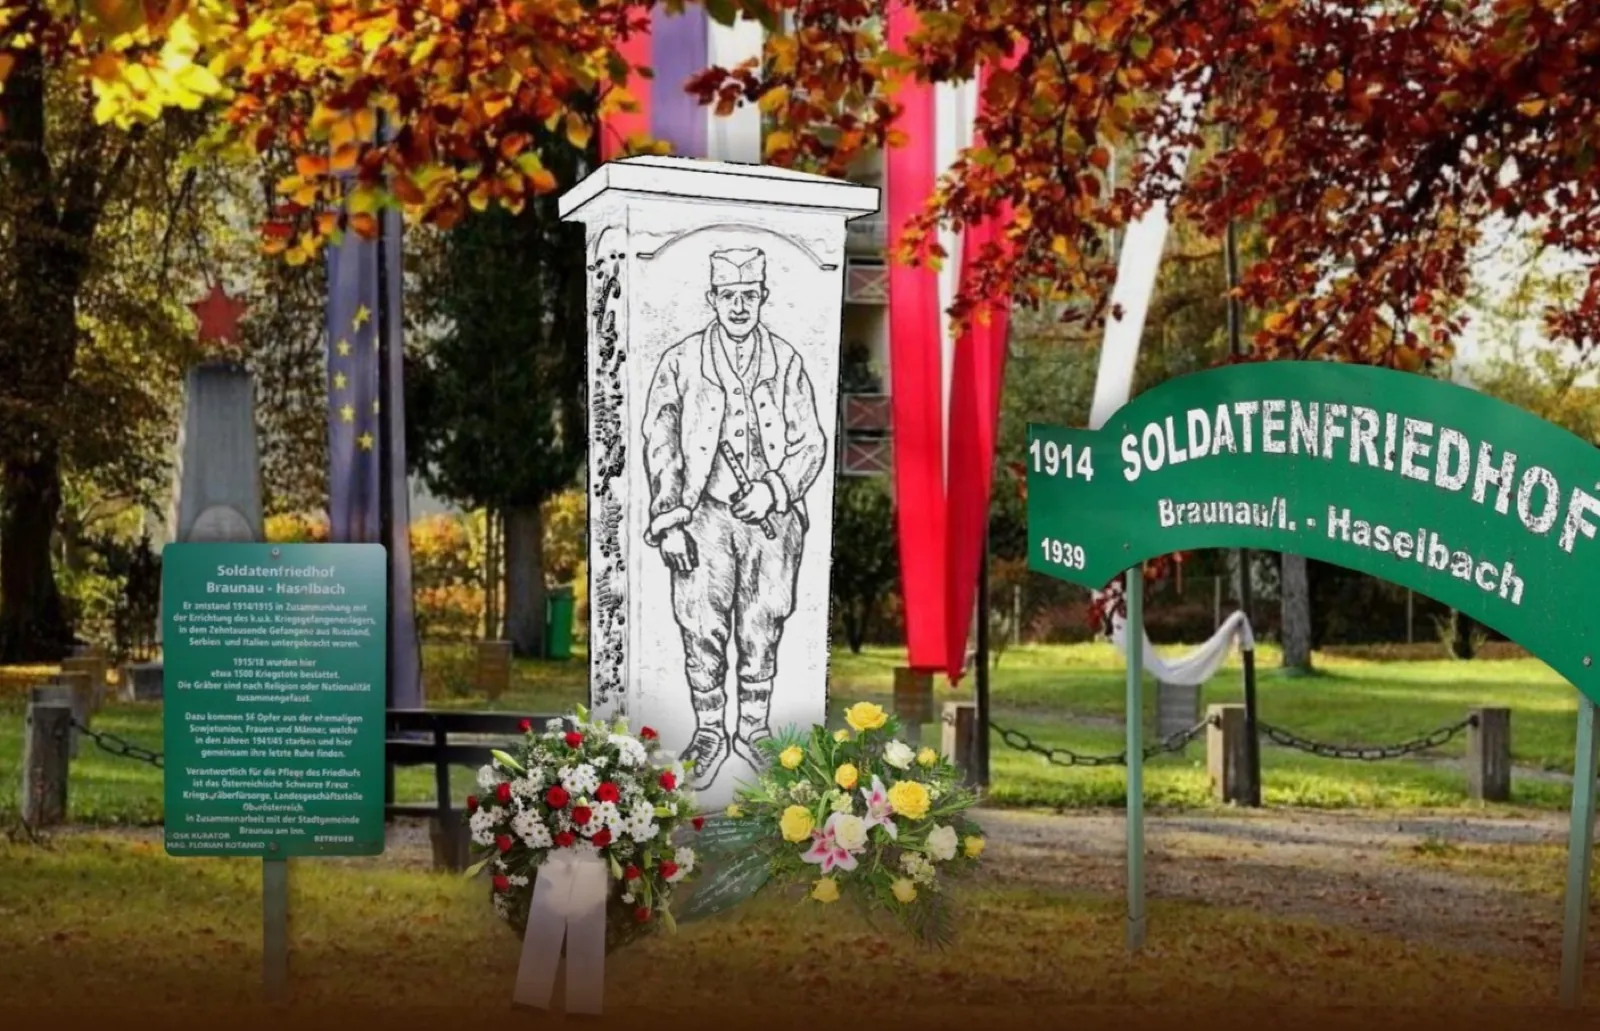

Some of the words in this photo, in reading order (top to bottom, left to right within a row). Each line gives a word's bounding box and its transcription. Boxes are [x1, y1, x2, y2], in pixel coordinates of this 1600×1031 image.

[1030, 439, 1094, 482] 1914
[1121, 399, 1600, 553] SOLDATENFRIEDHOF
[1041, 537, 1086, 570] 1939
[1327, 505, 1525, 605] Haselbach
[217, 565, 335, 577] Soldatenfriedhof
[206, 582, 264, 593] Braunau
[276, 583, 345, 594] Haselbach
[183, 602, 191, 610] Er
[275, 602, 283, 611] in
[286, 603, 351, 613] Zusammenhang
[173, 613, 187, 622] der
[189, 614, 232, 624] Errichtung
[179, 626, 187, 634] in
[189, 626, 207, 634] dem
[209, 626, 267, 635] Zehntausende
[269, 627, 314, 636] Gefangene
[189, 637, 221, 646] Serbien
[225, 638, 241, 646] und
[243, 638, 269, 646] Italien
[272, 638, 330, 649] untergebracht
[266, 658, 297, 667] wurden
[299, 658, 316, 667] hier
[211, 669, 232, 677] etwa
[255, 670, 298, 680] Kriegstote
[178, 681, 191, 690] Die
[193, 681, 221, 690] Gräber
[223, 681, 241, 690] sind
[243, 681, 262, 690] nach
[264, 682, 298, 692] Religion
[300, 682, 320, 690] oder
[321, 682, 371, 691] Nationalität
[185, 712, 206, 720] Dazu
[207, 712, 243, 720] kommen
[257, 712, 280, 723] Opfer
[282, 714, 297, 722] aus
[299, 713, 313, 722] der
[314, 714, 363, 724] ehemaligen
[246, 725, 274, 733] Frauen
[276, 725, 292, 733] und
[329, 726, 358, 734] welche
[195, 736, 203, 744] in
[205, 736, 221, 744] den
[222, 736, 249, 744] Jahren
[285, 736, 316, 745] starben
[318, 737, 334, 745] und
[336, 737, 353, 746] hier
[201, 748, 248, 758] gemeinsam
[250, 748, 266, 757] ihre
[269, 749, 292, 757] letzte
[294, 749, 315, 757] Ruhe
[186, 766, 247, 776] Verantwortlich
[248, 766, 261, 776] für
[263, 767, 276, 776] die
[278, 767, 304, 779] Pflege
[306, 767, 320, 777] des
[321, 768, 361, 777] Friedhofs
[193, 779, 202, 787] ist
[205, 779, 219, 788] das
[221, 777, 283, 788] Österreichische
[285, 780, 323, 789] Schwarze
[325, 780, 349, 789] Kreuz
[185, 814, 194, 822] in
[196, 813, 264, 823] Zusammenarbeit
[266, 814, 280, 823] mit
[282, 814, 296, 823] der
[298, 814, 360, 825] Stadtgemeinde
[240, 826, 273, 834] Braunau
